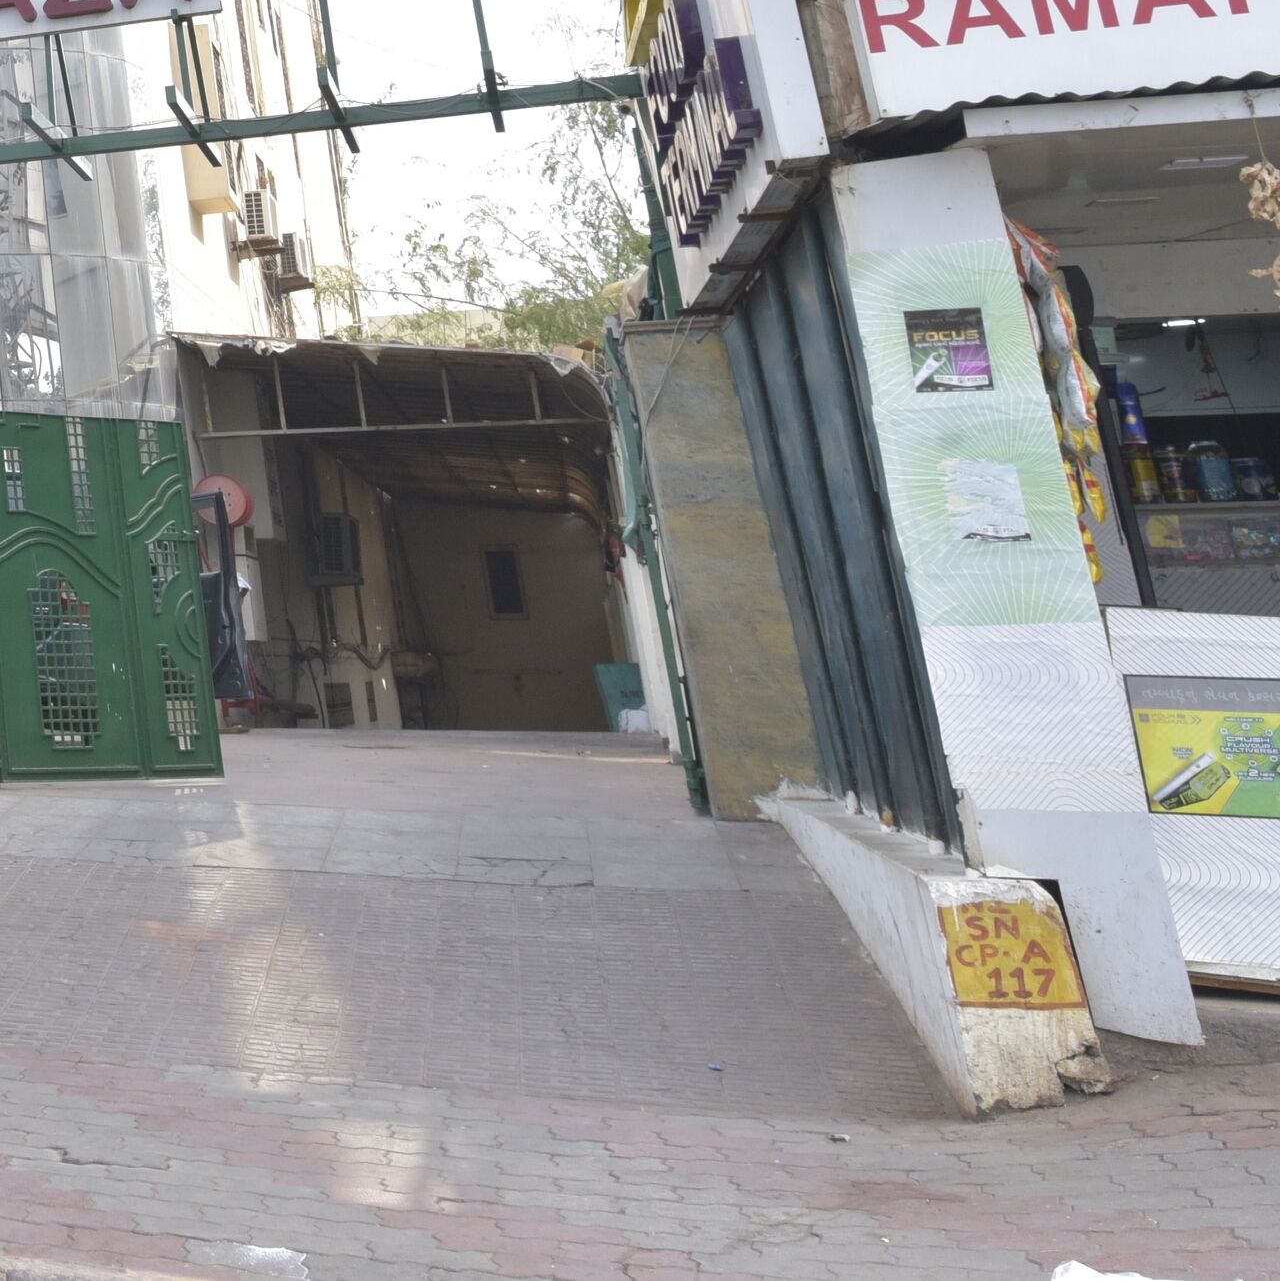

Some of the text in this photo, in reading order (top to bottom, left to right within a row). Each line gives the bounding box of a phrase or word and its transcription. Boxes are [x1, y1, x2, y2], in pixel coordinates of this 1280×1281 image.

[913, 330, 979, 343] FOCUS
[964, 915, 1020, 941] SN
[986, 967, 1056, 998] 117
